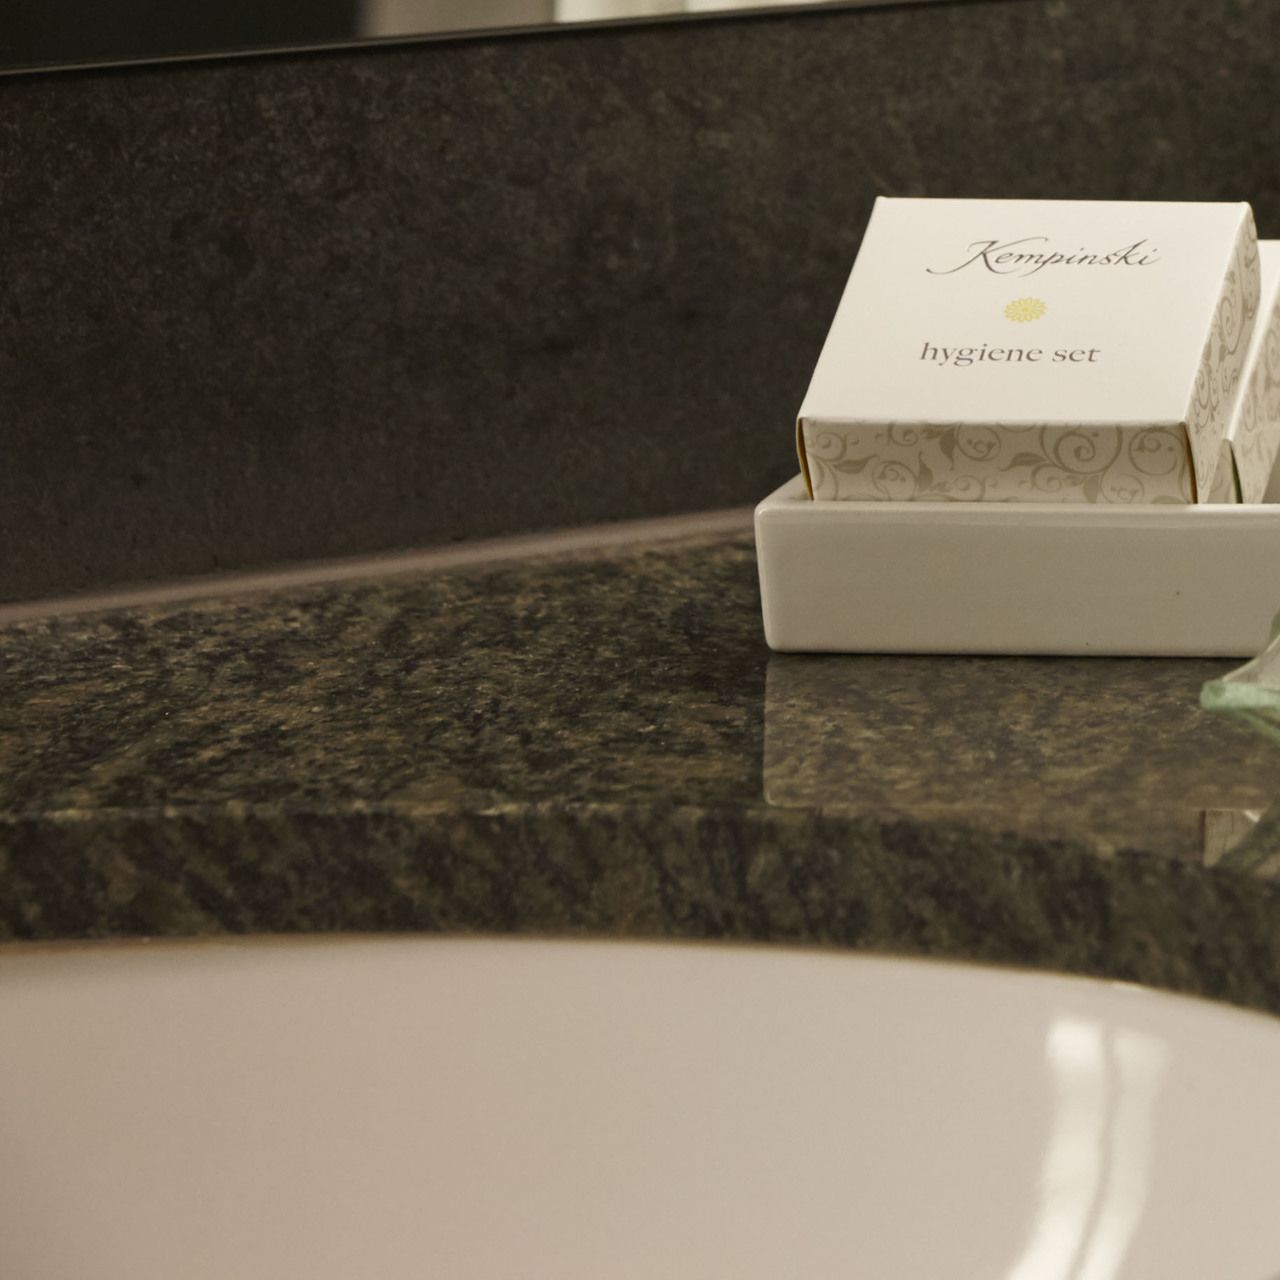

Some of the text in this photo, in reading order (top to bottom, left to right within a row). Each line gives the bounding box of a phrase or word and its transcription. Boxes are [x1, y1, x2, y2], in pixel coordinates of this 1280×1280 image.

[926, 237, 1161, 277] Kempinski
[920, 341, 1101, 367] hygiene set
